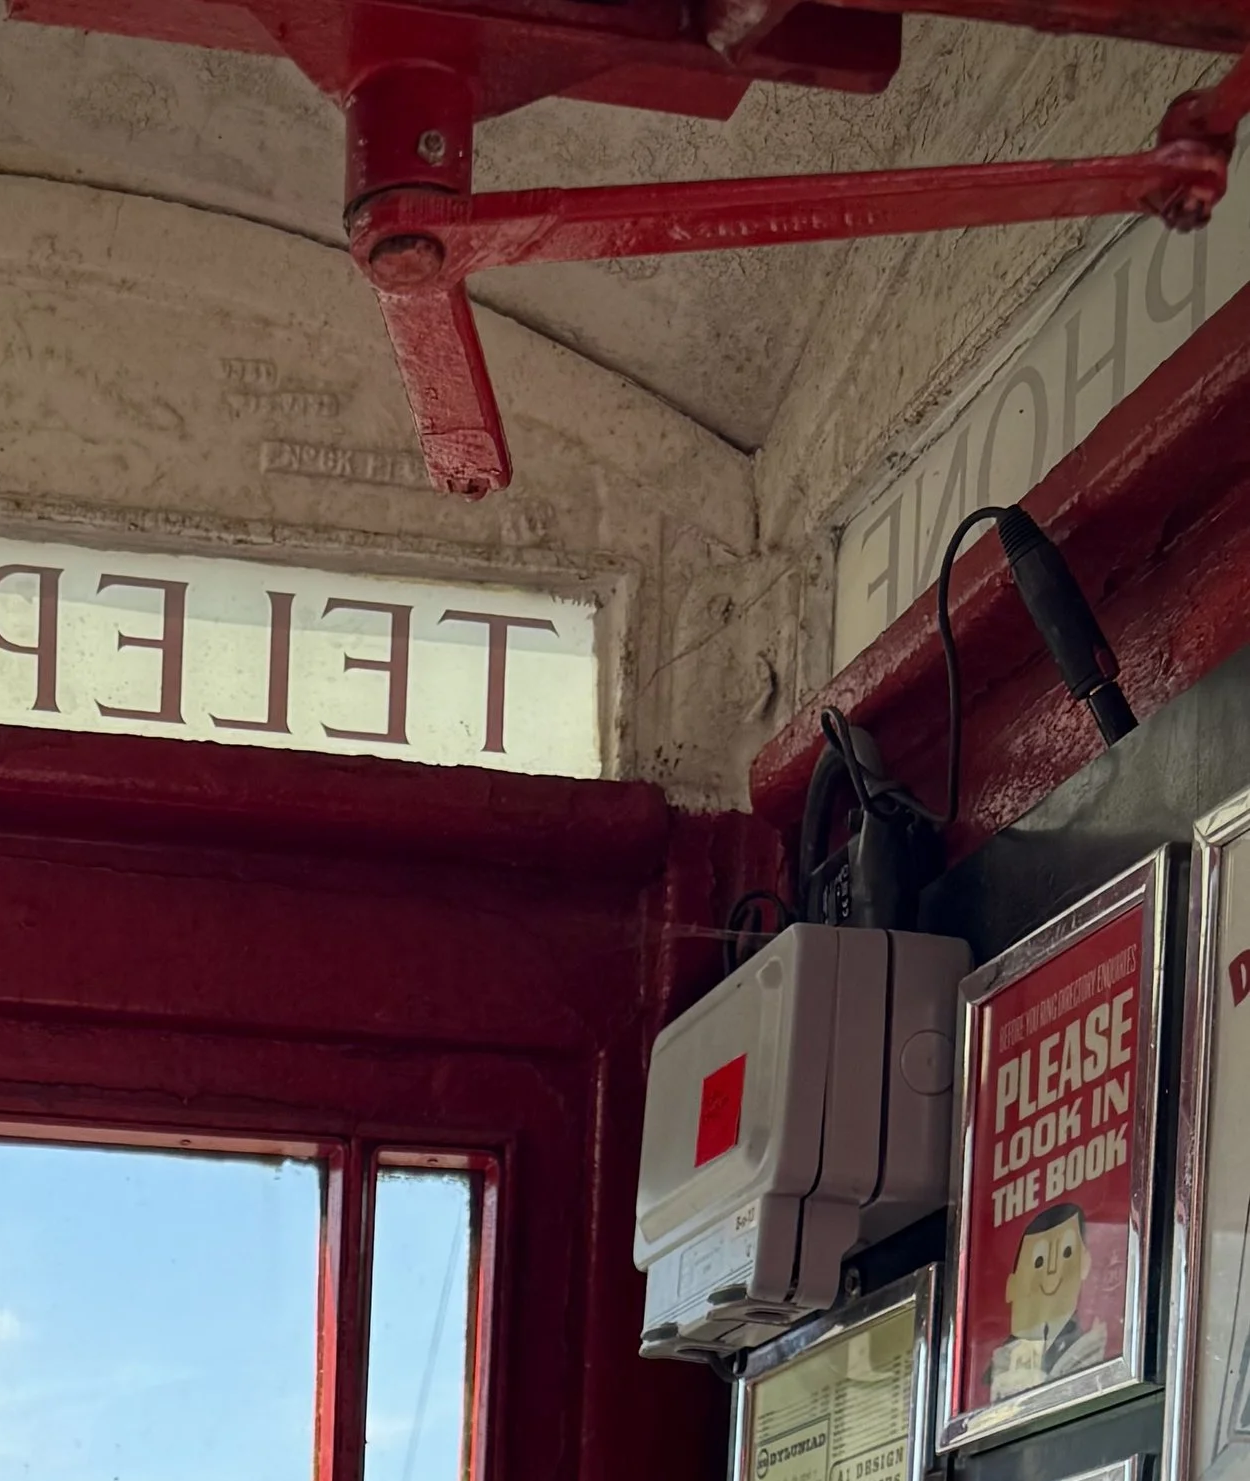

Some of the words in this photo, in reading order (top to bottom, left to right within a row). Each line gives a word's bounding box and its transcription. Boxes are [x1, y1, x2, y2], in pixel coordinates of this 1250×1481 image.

[1058, 968, 1097, 1018] DIRECTORY
[1097, 943, 1137, 993] ENQUIRIES
[995, 987, 1134, 1134] PLEASE
[991, 1168, 1041, 1229] THE
[1045, 1122, 1128, 1201] BOOK
[993, 1096, 1084, 1182] LOOK
[1091, 1071, 1130, 1129] IN
[856, 1446, 904, 1480] DESIGN
